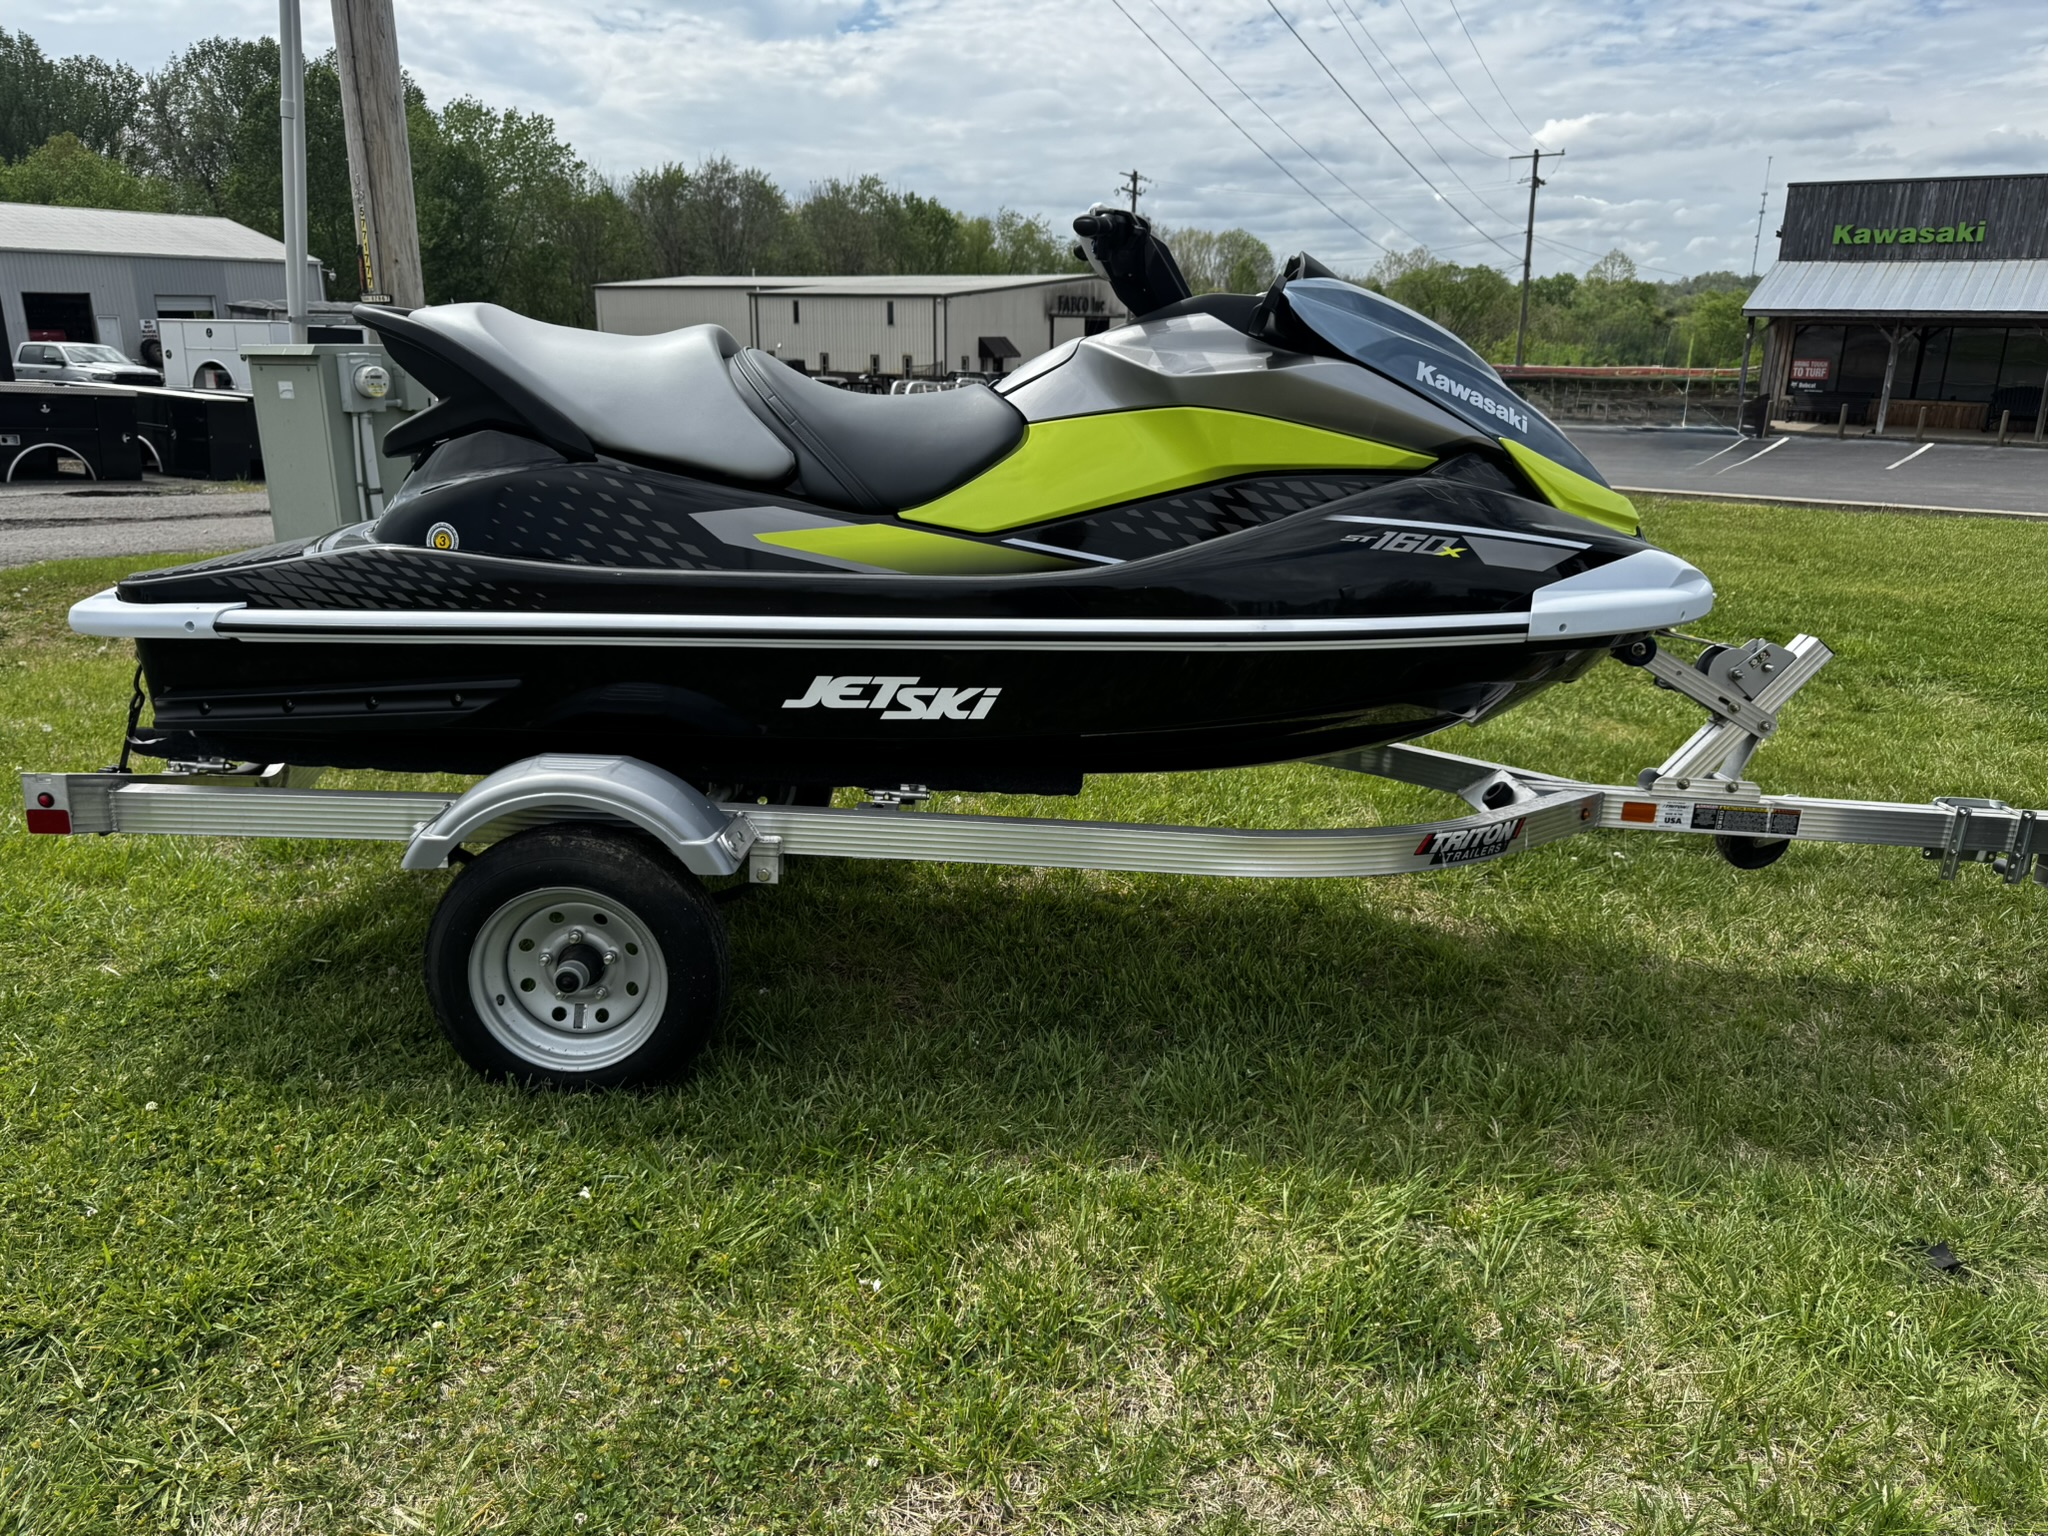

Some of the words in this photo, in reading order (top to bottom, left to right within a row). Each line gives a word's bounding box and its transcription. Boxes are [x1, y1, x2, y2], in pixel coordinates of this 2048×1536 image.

[1832, 220, 1987, 245] Kawasaki
[1793, 367, 1804, 377] TO
[1805, 367, 1827, 378] TURF
[1416, 360, 1528, 434] Kawasaki
[1429, 819, 1519, 854] TRITON
[1446, 843, 1502, 861] TRAILERS
